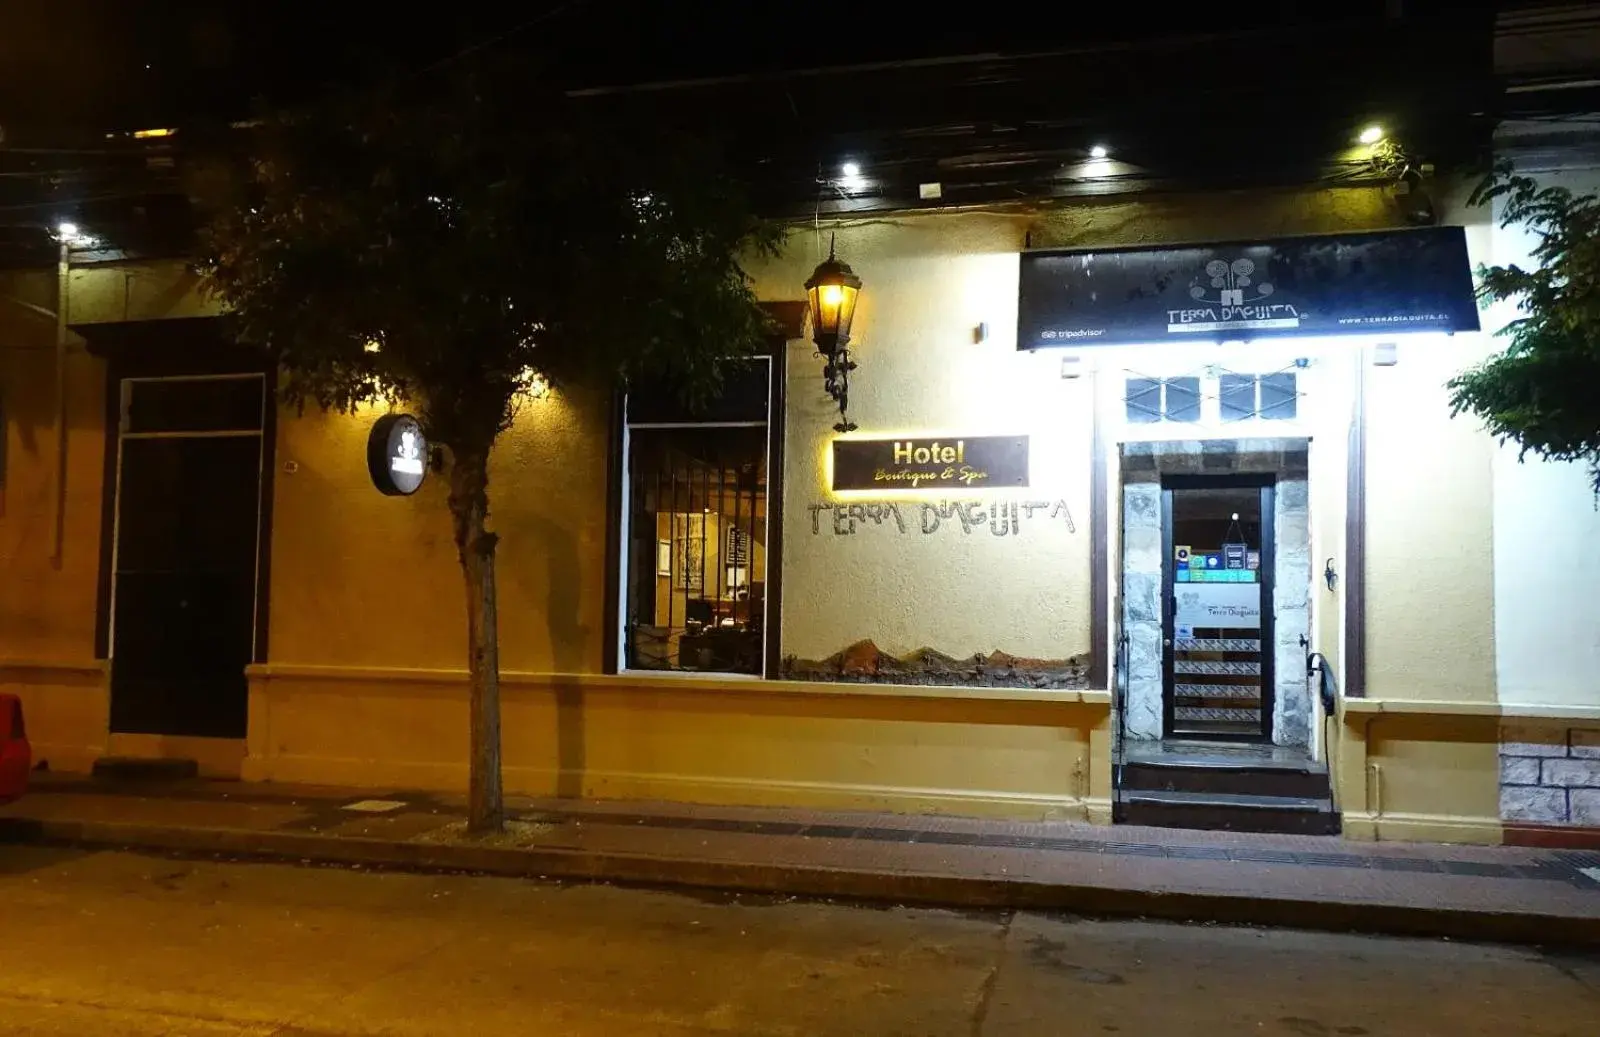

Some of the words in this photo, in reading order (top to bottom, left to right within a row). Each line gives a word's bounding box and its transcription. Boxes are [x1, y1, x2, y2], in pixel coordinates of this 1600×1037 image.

[1167, 309, 1217, 323] TERRA
[1222, 302, 1298, 320] DIAGUITA
[1058, 328, 1104, 339] tripadvisor
[894, 440, 964, 464] Hotel
[874, 467, 938, 487] Boutique
[940, 466, 955, 479] &
[959, 465, 989, 485] Spa
[807, 501, 905, 536] TERRA
[921, 499, 1076, 537] DIAGUITA
